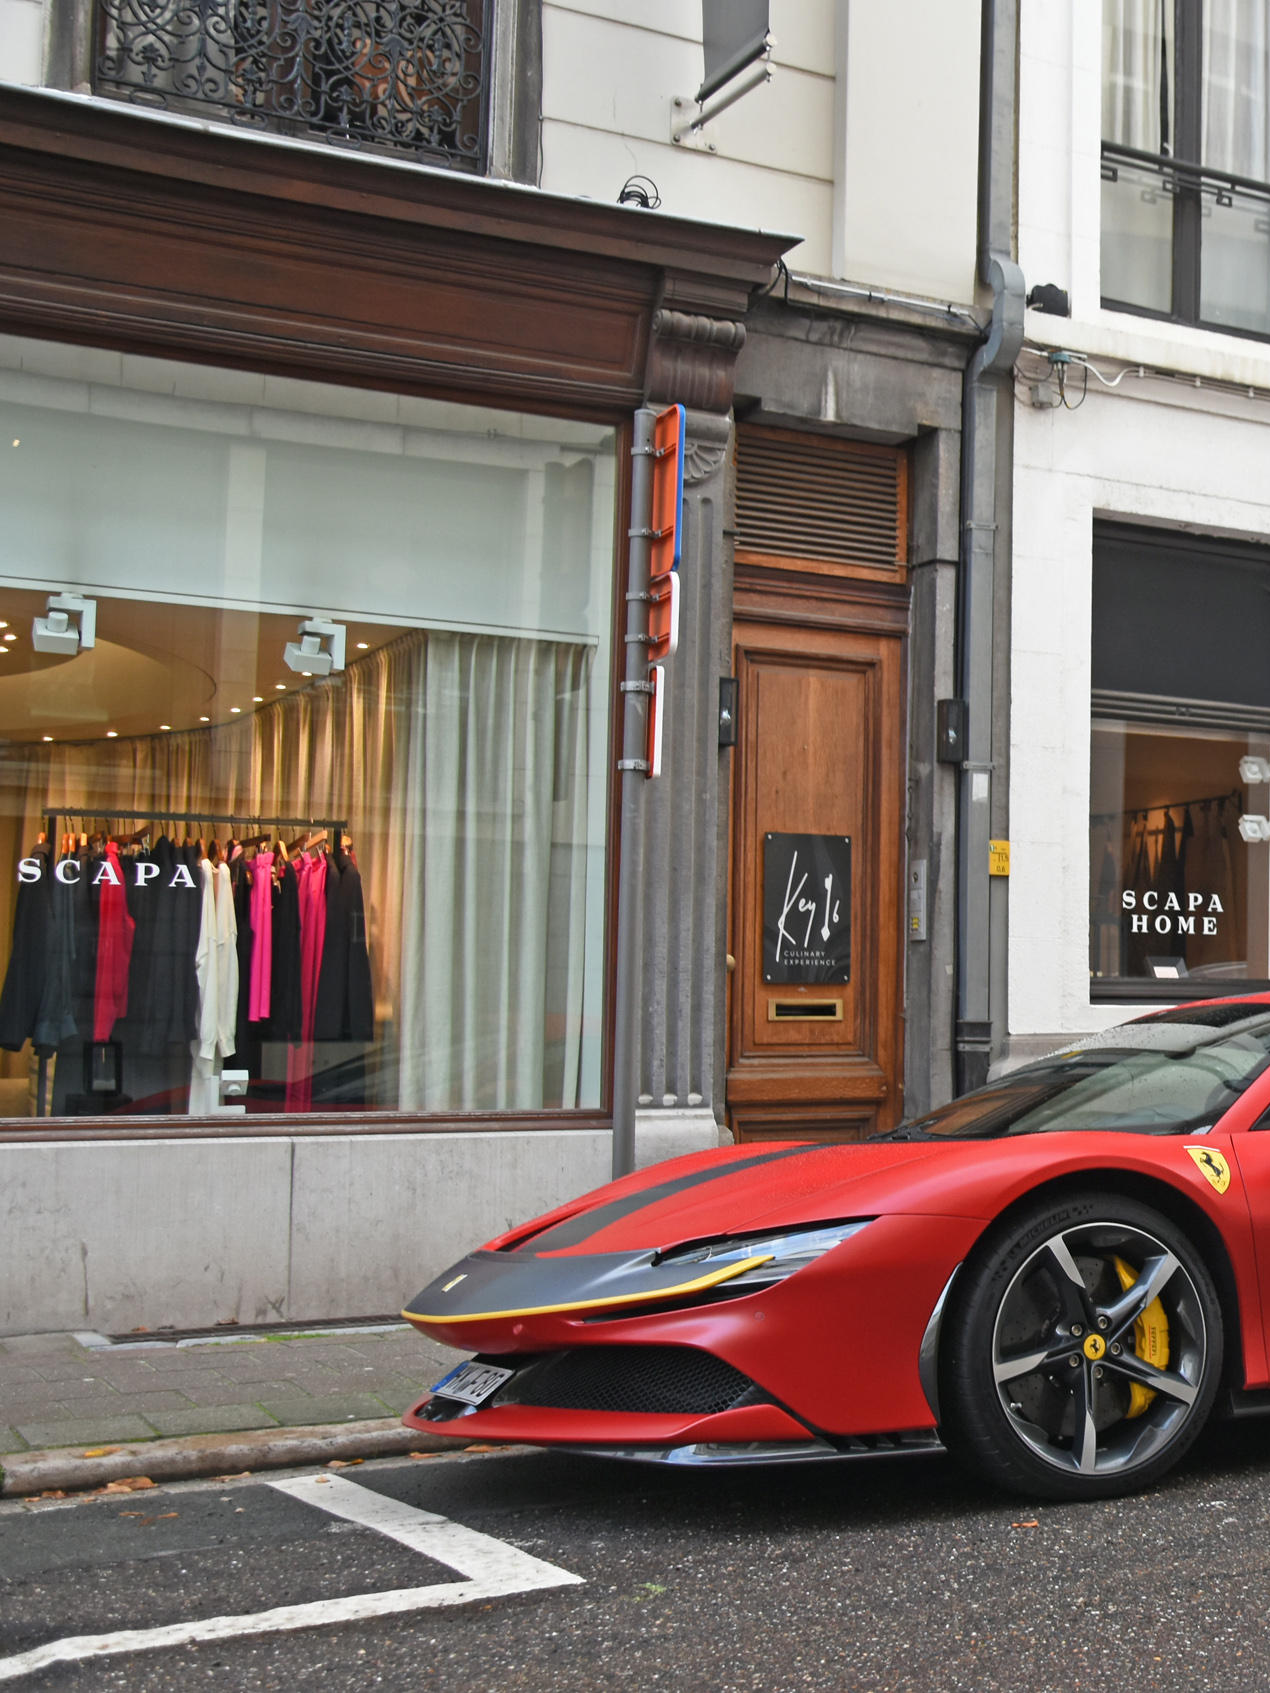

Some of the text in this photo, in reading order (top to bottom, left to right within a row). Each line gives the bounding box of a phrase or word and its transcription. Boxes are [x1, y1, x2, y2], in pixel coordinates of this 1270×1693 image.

[17, 857, 197, 888] SCAPA
[1122, 889, 1224, 913] SCAPA
[1131, 914, 1218, 936] HOME
[783, 950, 826, 958] CULINARY
[784, 959, 836, 967] EXPERIENCE
